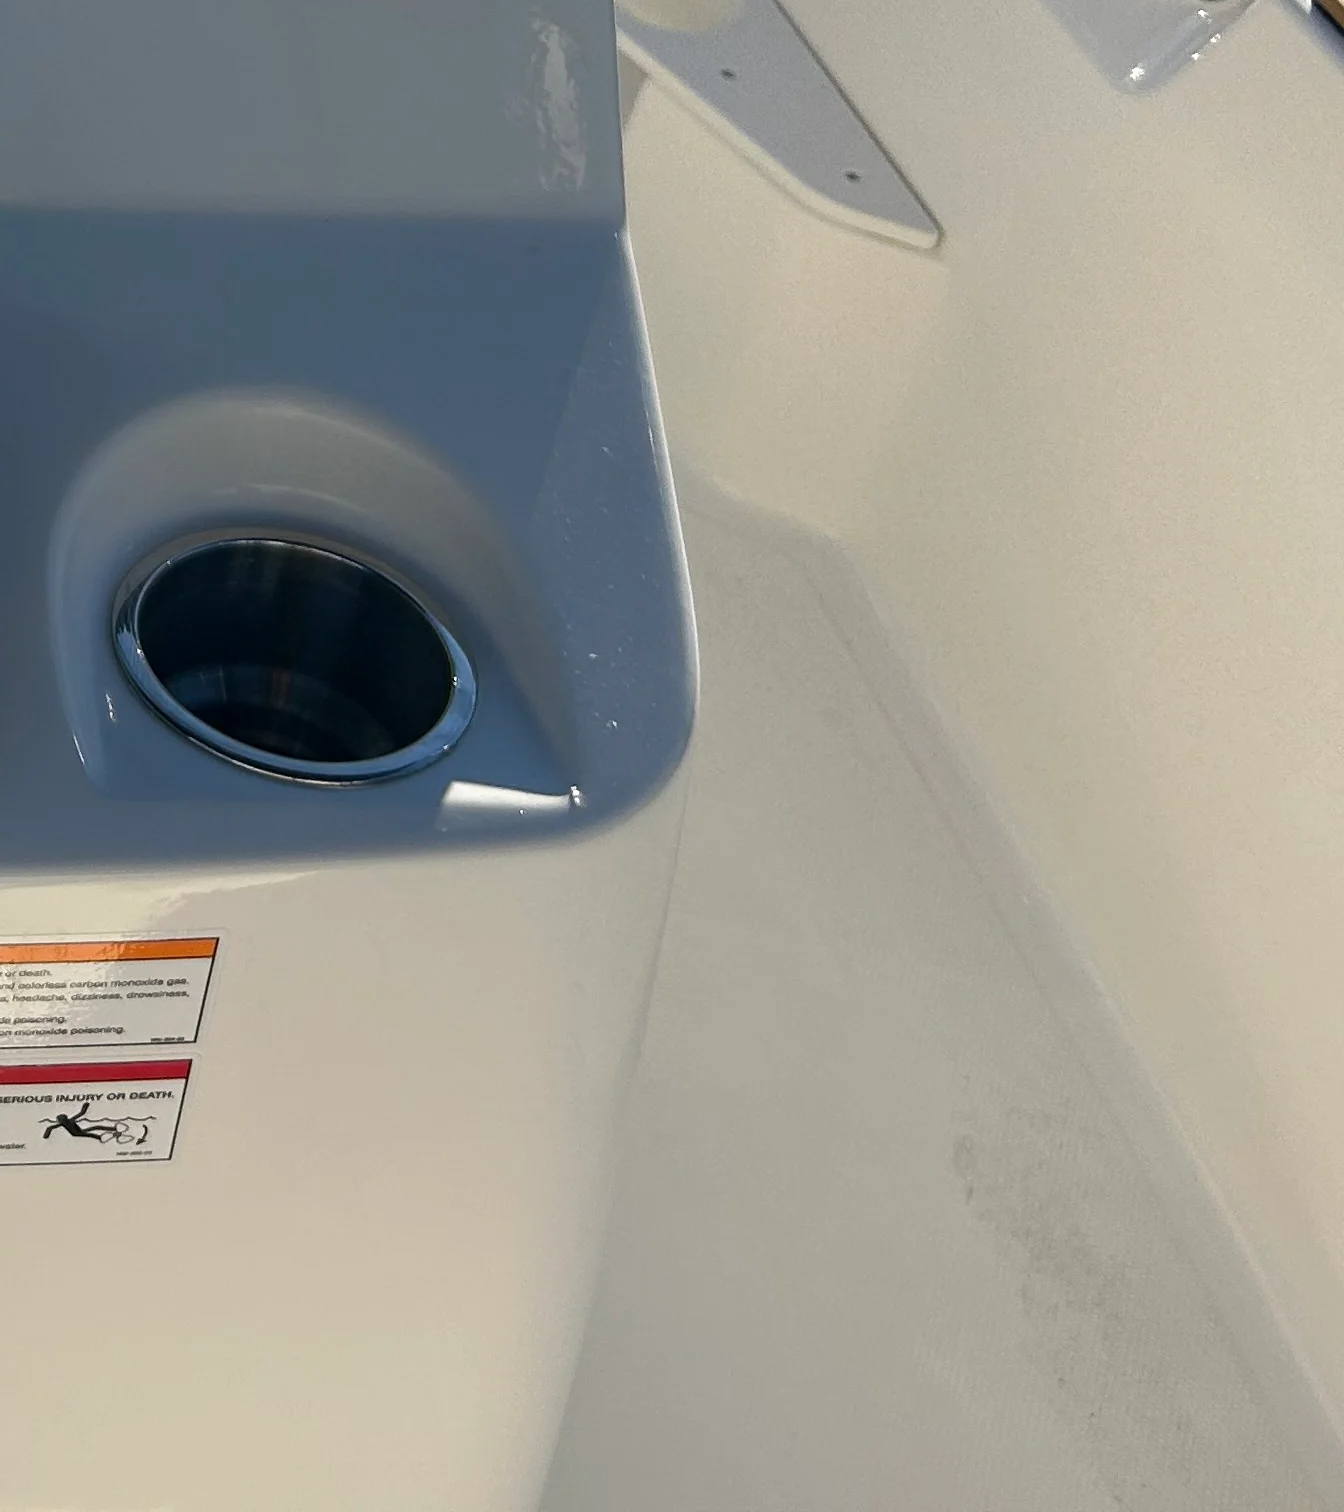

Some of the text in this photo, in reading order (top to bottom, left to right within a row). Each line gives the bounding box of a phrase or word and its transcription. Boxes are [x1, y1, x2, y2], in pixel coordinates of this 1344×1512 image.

[56, 1092, 102, 1102] INJURY
[106, 1092, 126, 1101] OR
[129, 1090, 174, 1100] DEATH.
